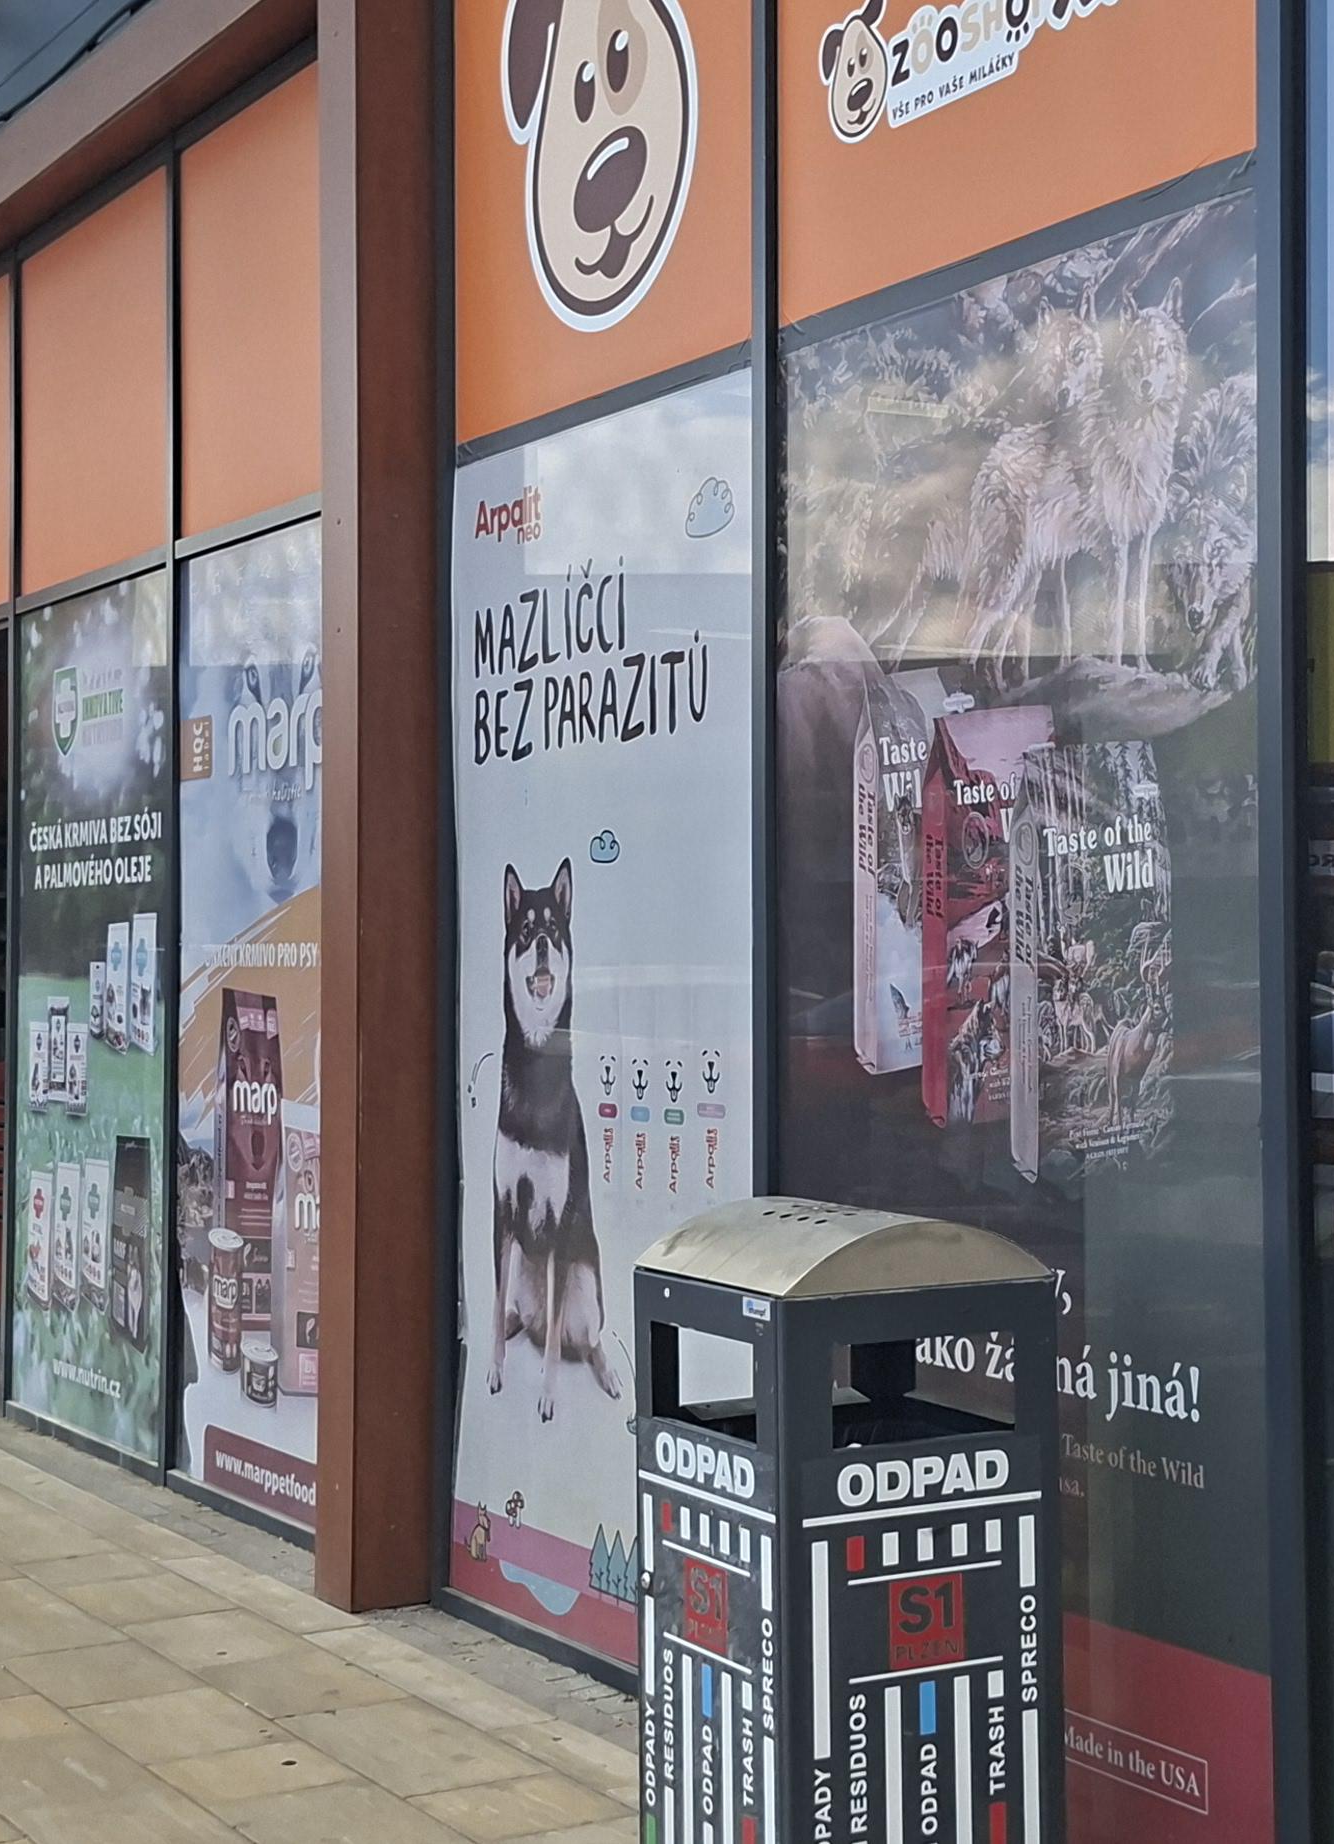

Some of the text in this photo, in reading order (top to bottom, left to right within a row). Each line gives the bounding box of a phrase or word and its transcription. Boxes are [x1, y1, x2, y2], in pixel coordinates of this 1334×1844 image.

[892, 52, 1015, 121] VŠE PRO VAŠE MILÁČKY
[475, 486, 541, 542] Arpalit
[517, 522, 541, 545] neo
[228, 689, 322, 791] marp
[474, 678, 533, 765] BEZ
[879, 737, 927, 765] Taste
[882, 768, 923, 812] Wil
[954, 772, 1015, 806] Taste of
[29, 806, 162, 852] ČESKÁ KRMIVA BEZ SÓJI
[867, 791, 876, 847] Taste
[1043, 814, 1152, 857] Taste of the
[34, 854, 152, 890] A PALMOVÉHO OLEJE
[1103, 849, 1155, 893] Wild
[278, 942, 297, 968] PRO
[299, 942, 319, 968] PSY
[233, 1080, 278, 1125] marp
[52, 1358, 121, 1399] www.nutrin.cz
[915, 1335, 976, 1372] ako
[1105, 1351, 1200, 1422] jiná!
[655, 1432, 755, 1499] ODPAD
[837, 1448, 1010, 1507] ODPAD
[1062, 1433, 1205, 1489] Taste of the Wild
[690, 1567, 722, 1620] S1
[899, 1581, 955, 1635] S1
[761, 1617, 775, 1735] SPRECO
[1020, 1594, 1038, 1703] SPRECO
[663, 1648, 675, 1787] RESIDUOS
[644, 1701, 657, 1807] ODPADY
[702, 1725, 714, 1815] ODPAD
[743, 1718, 755, 1807] TRASH
[849, 1693, 868, 1834] RESIDUOS
[988, 1706, 1006, 1795] TRASH
[1064, 1726, 1201, 1797] Made in the USA
[920, 1743, 938, 1835] ODPAD
